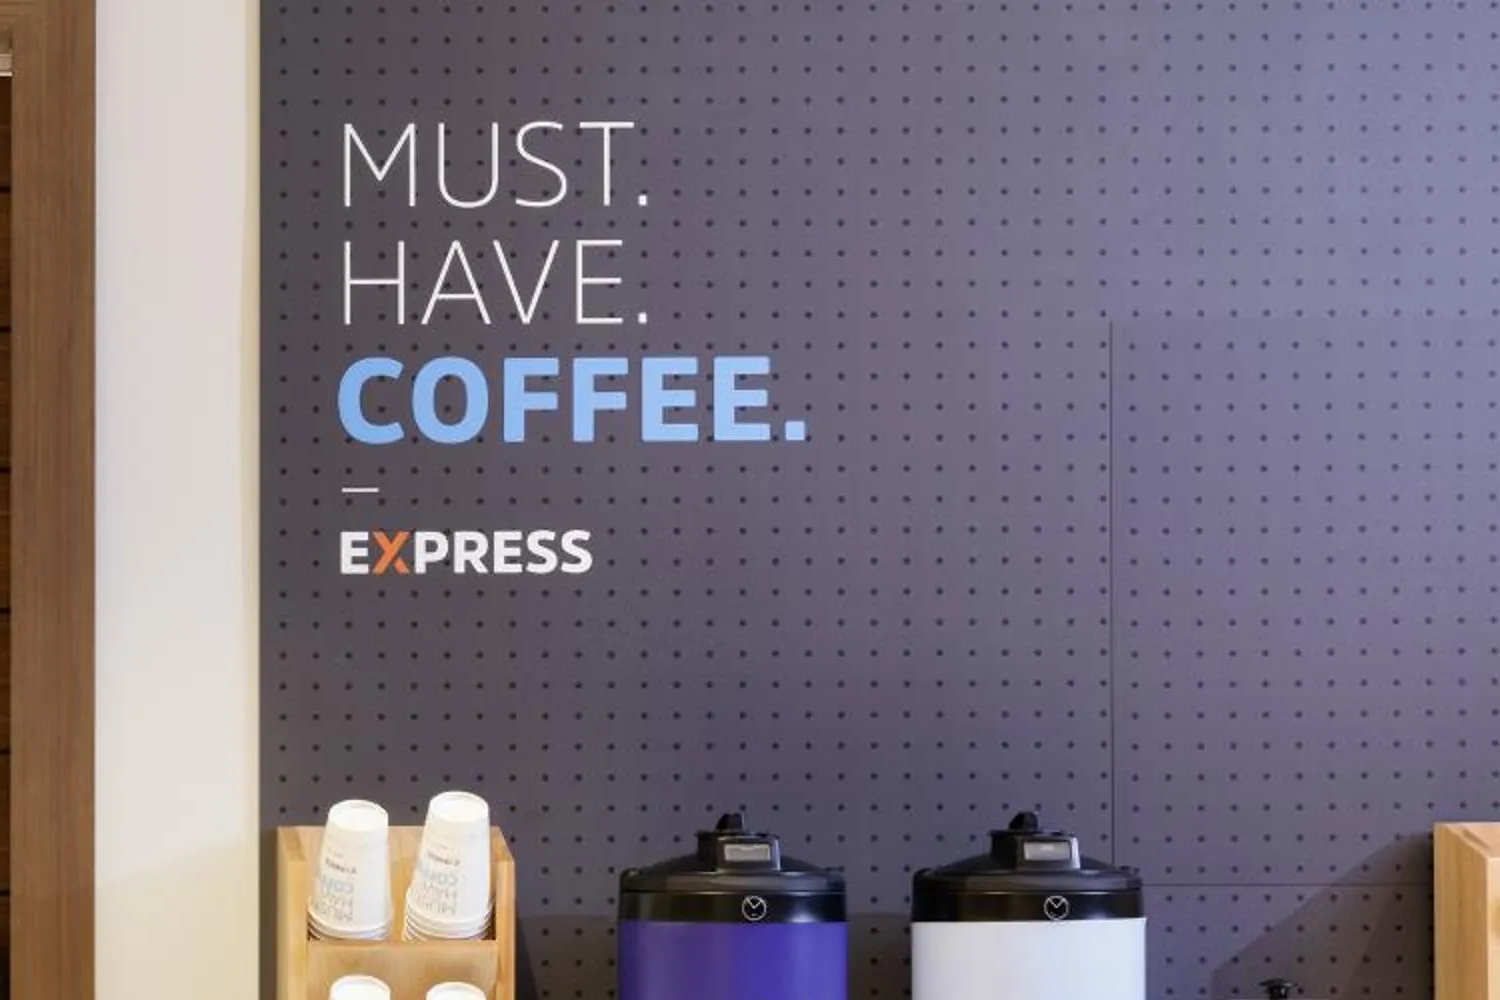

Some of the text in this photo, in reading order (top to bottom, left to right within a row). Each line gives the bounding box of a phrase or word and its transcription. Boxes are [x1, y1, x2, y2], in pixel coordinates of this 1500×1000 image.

[343, 120, 649, 208] MUST.
[343, 239, 649, 326] HAVE.
[337, 355, 807, 445] COFFEE.
[339, 529, 594, 576] EXPRESS
